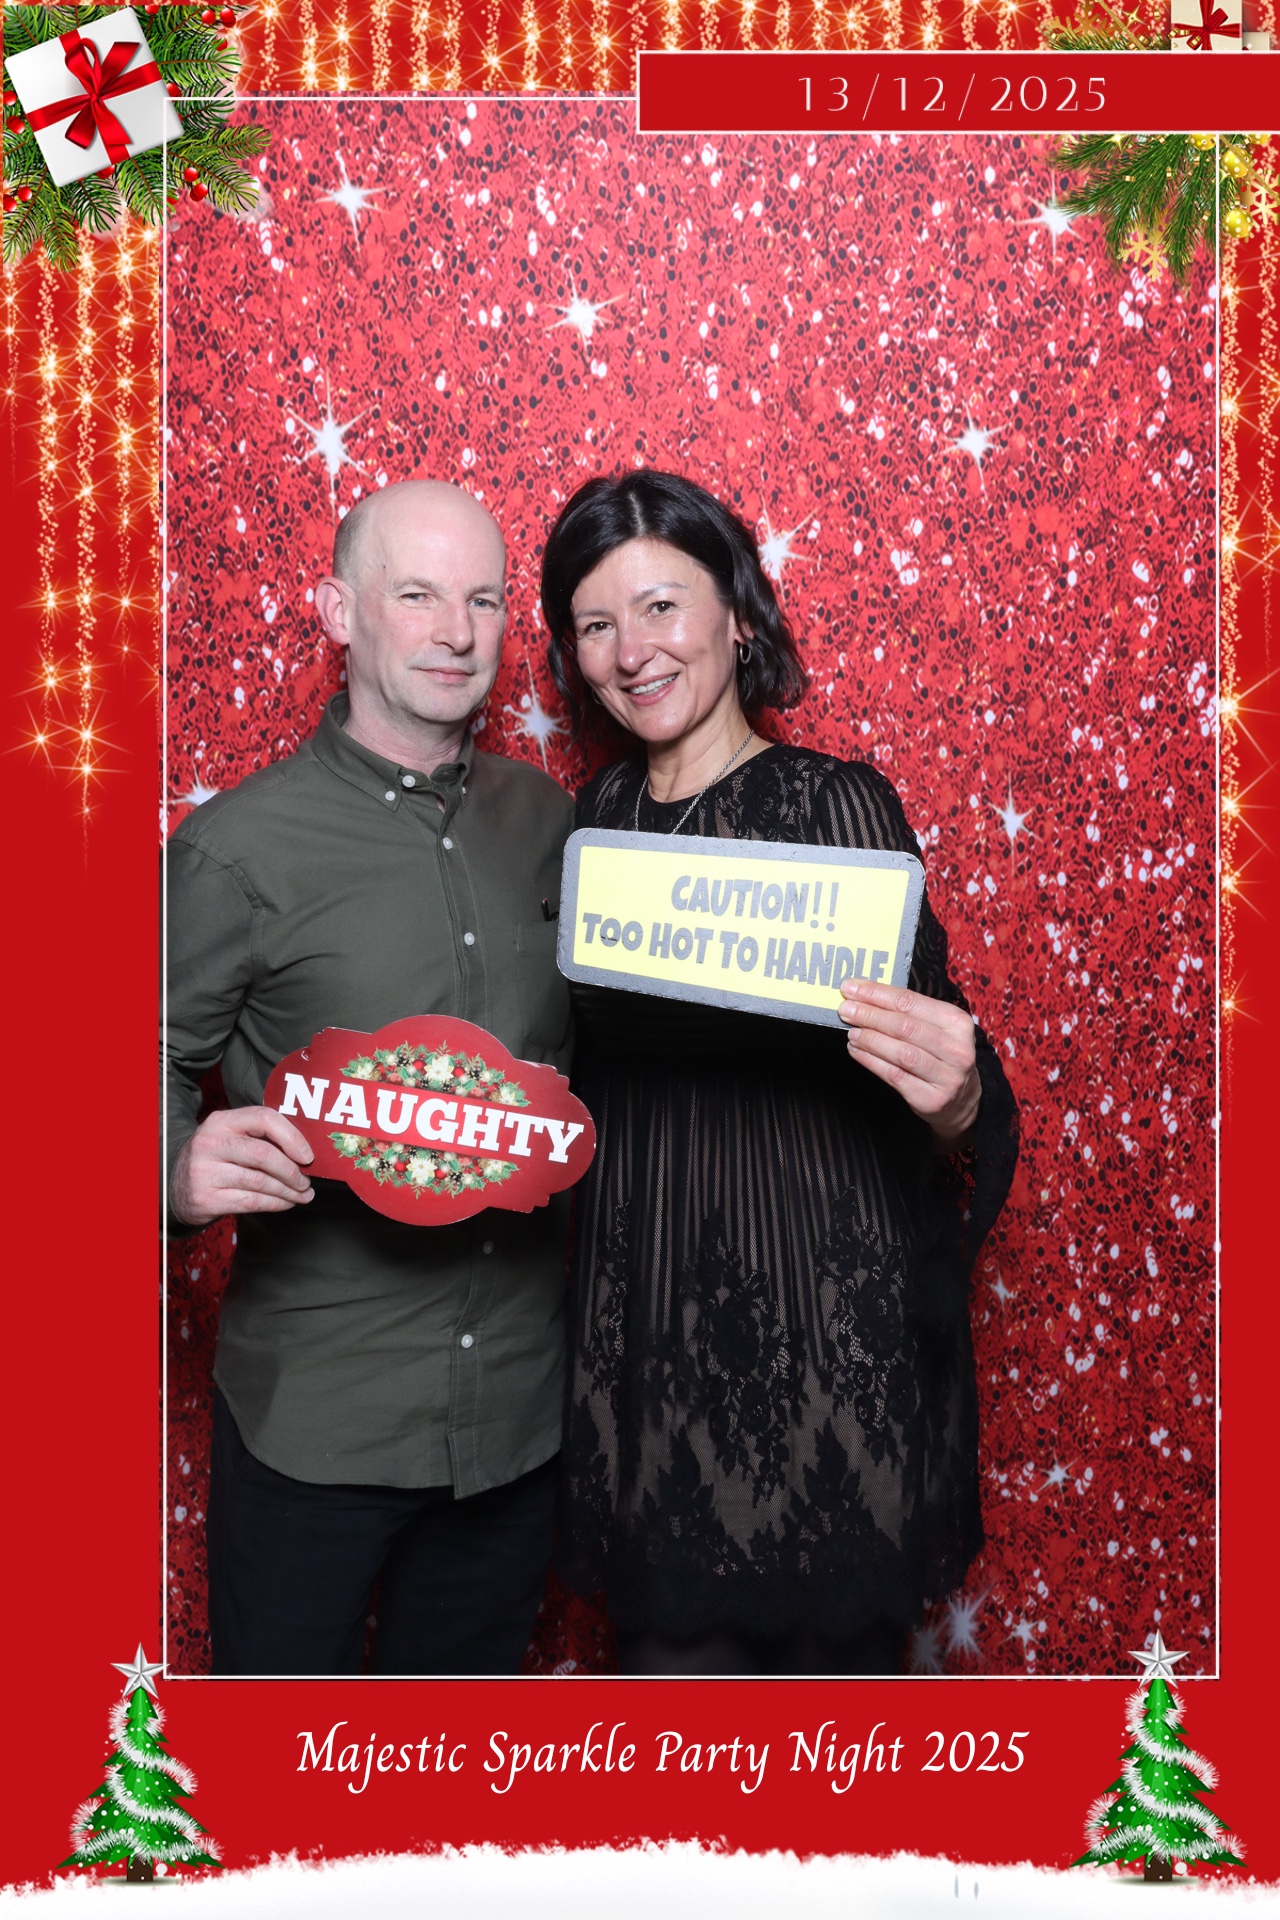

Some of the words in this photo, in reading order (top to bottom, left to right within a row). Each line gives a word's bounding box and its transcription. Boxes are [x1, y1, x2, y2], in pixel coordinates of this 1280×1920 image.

[671, 875, 839, 932] CAUTION!!
[582, 912, 644, 952] TOO
[648, 922, 714, 964] HOT
[719, 930, 759, 973] TO
[763, 937, 889, 990] HANDLE
[279, 1072, 585, 1164] NAUGHTY
